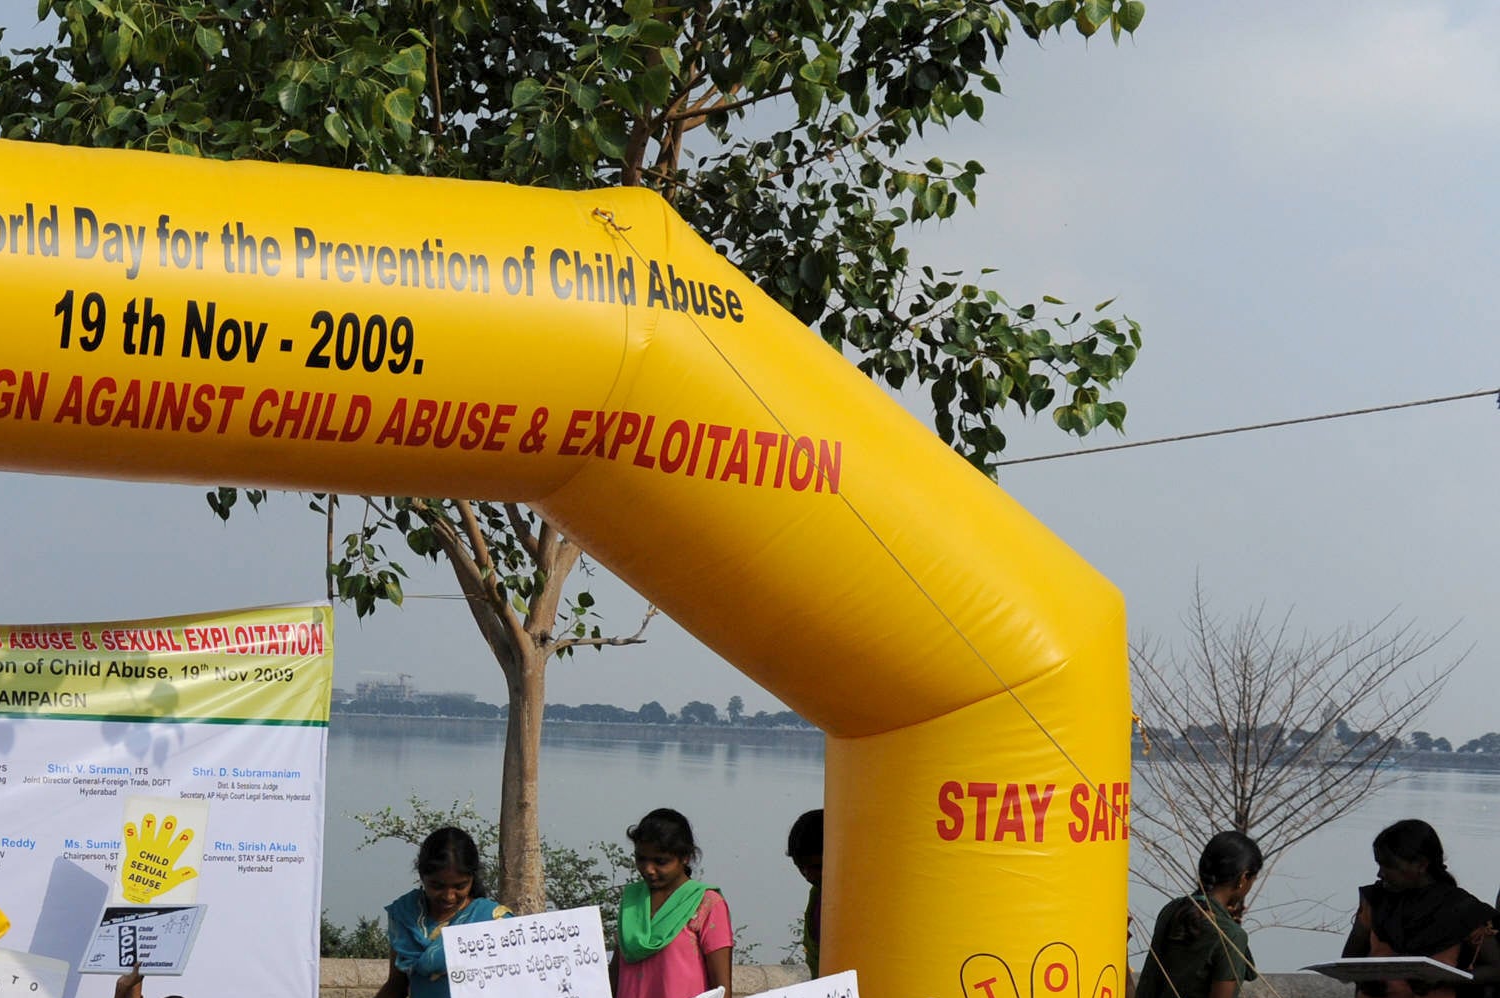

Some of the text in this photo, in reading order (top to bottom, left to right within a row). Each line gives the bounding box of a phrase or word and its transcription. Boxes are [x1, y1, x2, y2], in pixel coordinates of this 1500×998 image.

[74, 207, 145, 280] Day
[157, 215, 209, 270] for
[221, 220, 281, 276] the
[294, 227, 490, 293] Prevention
[503, 246, 535, 296] of
[550, 248, 636, 306] Child
[646, 261, 745, 323] Abuse
[54, 289, 424, 375] 19 th Nov 2009.
[54, 376, 246, 436] AGAINST
[248, 390, 372, 443] CHILD
[376, 398, 517, 451] ABUSE
[518, 407, 549, 455] &
[557, 410, 842, 495] EXPLOITATION
[9, 630, 79, 650] ABUSE
[82, 630, 98, 650] &
[101, 627, 182, 652] SEXUAL
[183, 622, 324, 656] EXPLOITATION
[24, 658, 44, 674] of
[50, 659, 100, 677] Child
[106, 661, 173, 681] Abuse,
[214, 667, 248, 682] Nov
[254, 667, 294, 683] 2009
[47, 764, 148, 776] Shri. V. Sraman, ITS
[192, 767, 301, 779] Shri. D. Subramaniam
[936, 781, 1129, 843] STAY SAFE
[1, 838, 36, 850] Reddy
[214, 841, 297, 852] Rtn. Sirish Akula
[139, 850, 169, 866] CHILD
[130, 860, 168, 880] SEXUAL
[128, 873, 162, 890] ABUSE
